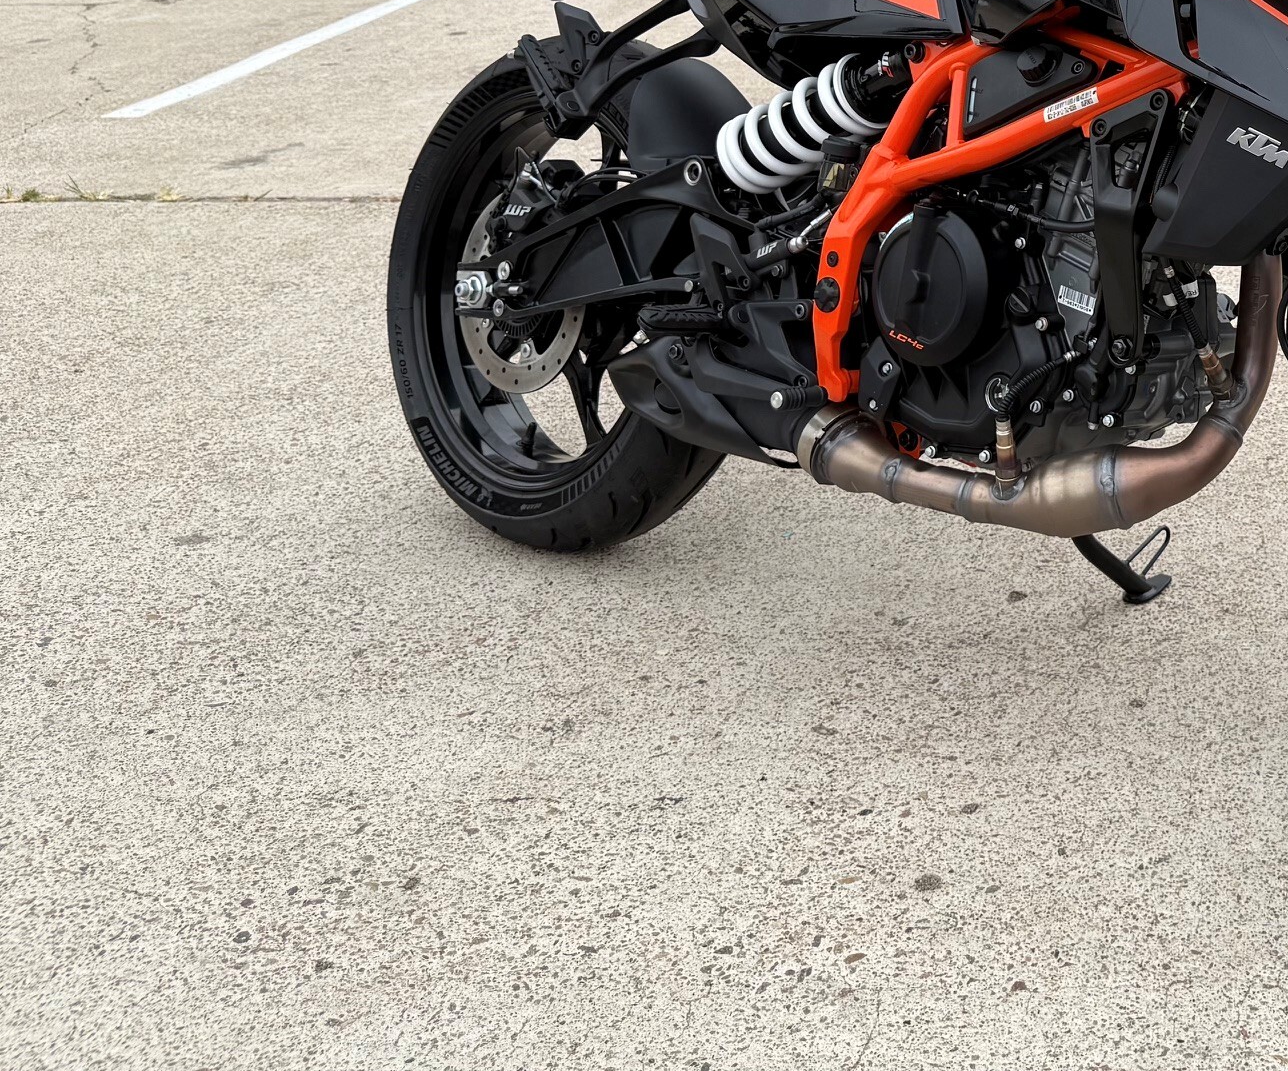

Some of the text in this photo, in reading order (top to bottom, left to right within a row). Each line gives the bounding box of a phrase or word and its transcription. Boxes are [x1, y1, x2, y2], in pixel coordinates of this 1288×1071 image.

[502, 203, 532, 217] WP
[756, 241, 778, 259] WP
[394, 323, 403, 336] 17
[396, 339, 405, 355] ZR
[398, 359, 414, 399] 150/60
[417, 424, 479, 497] MICHELIN
